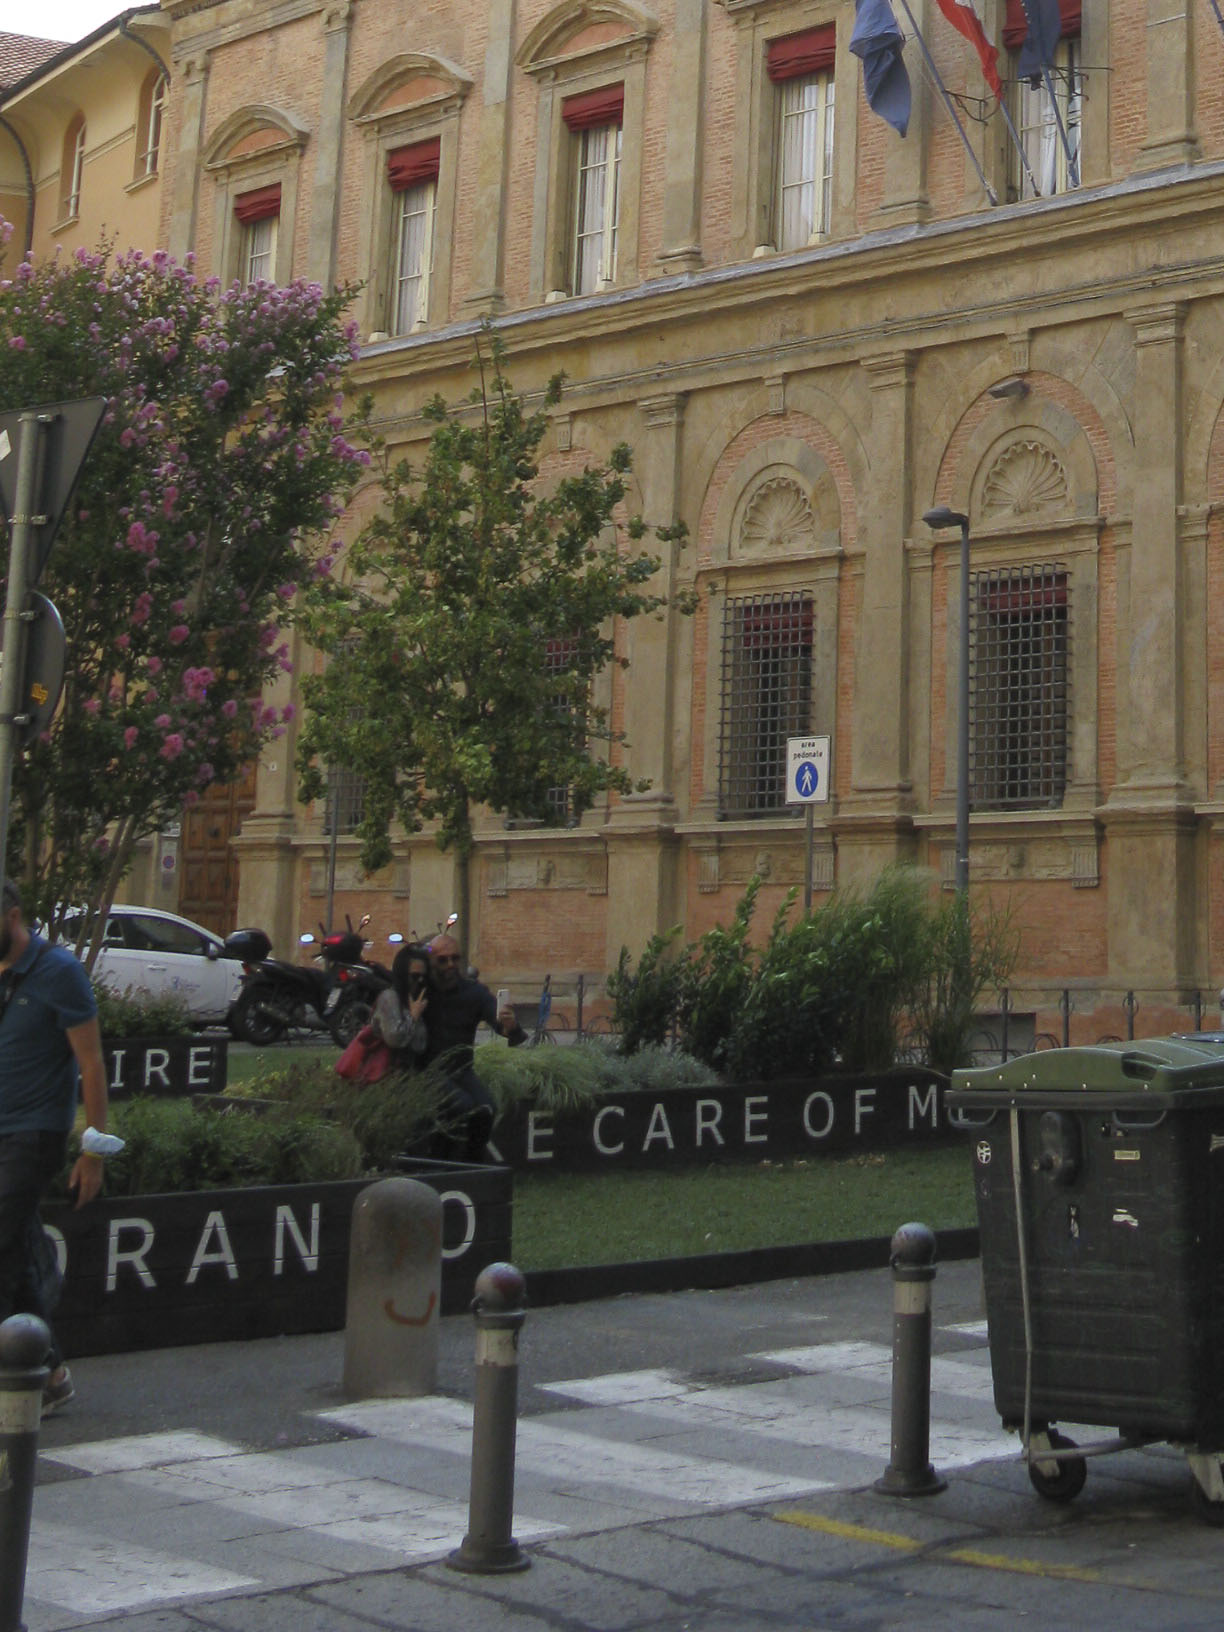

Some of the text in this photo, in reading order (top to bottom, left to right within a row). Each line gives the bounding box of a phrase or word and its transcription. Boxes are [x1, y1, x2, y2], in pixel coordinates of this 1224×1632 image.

[78, 1046, 212, 1088] IRE
[592, 1095, 770, 1155] CARE
[803, 1088, 877, 1138] OF
